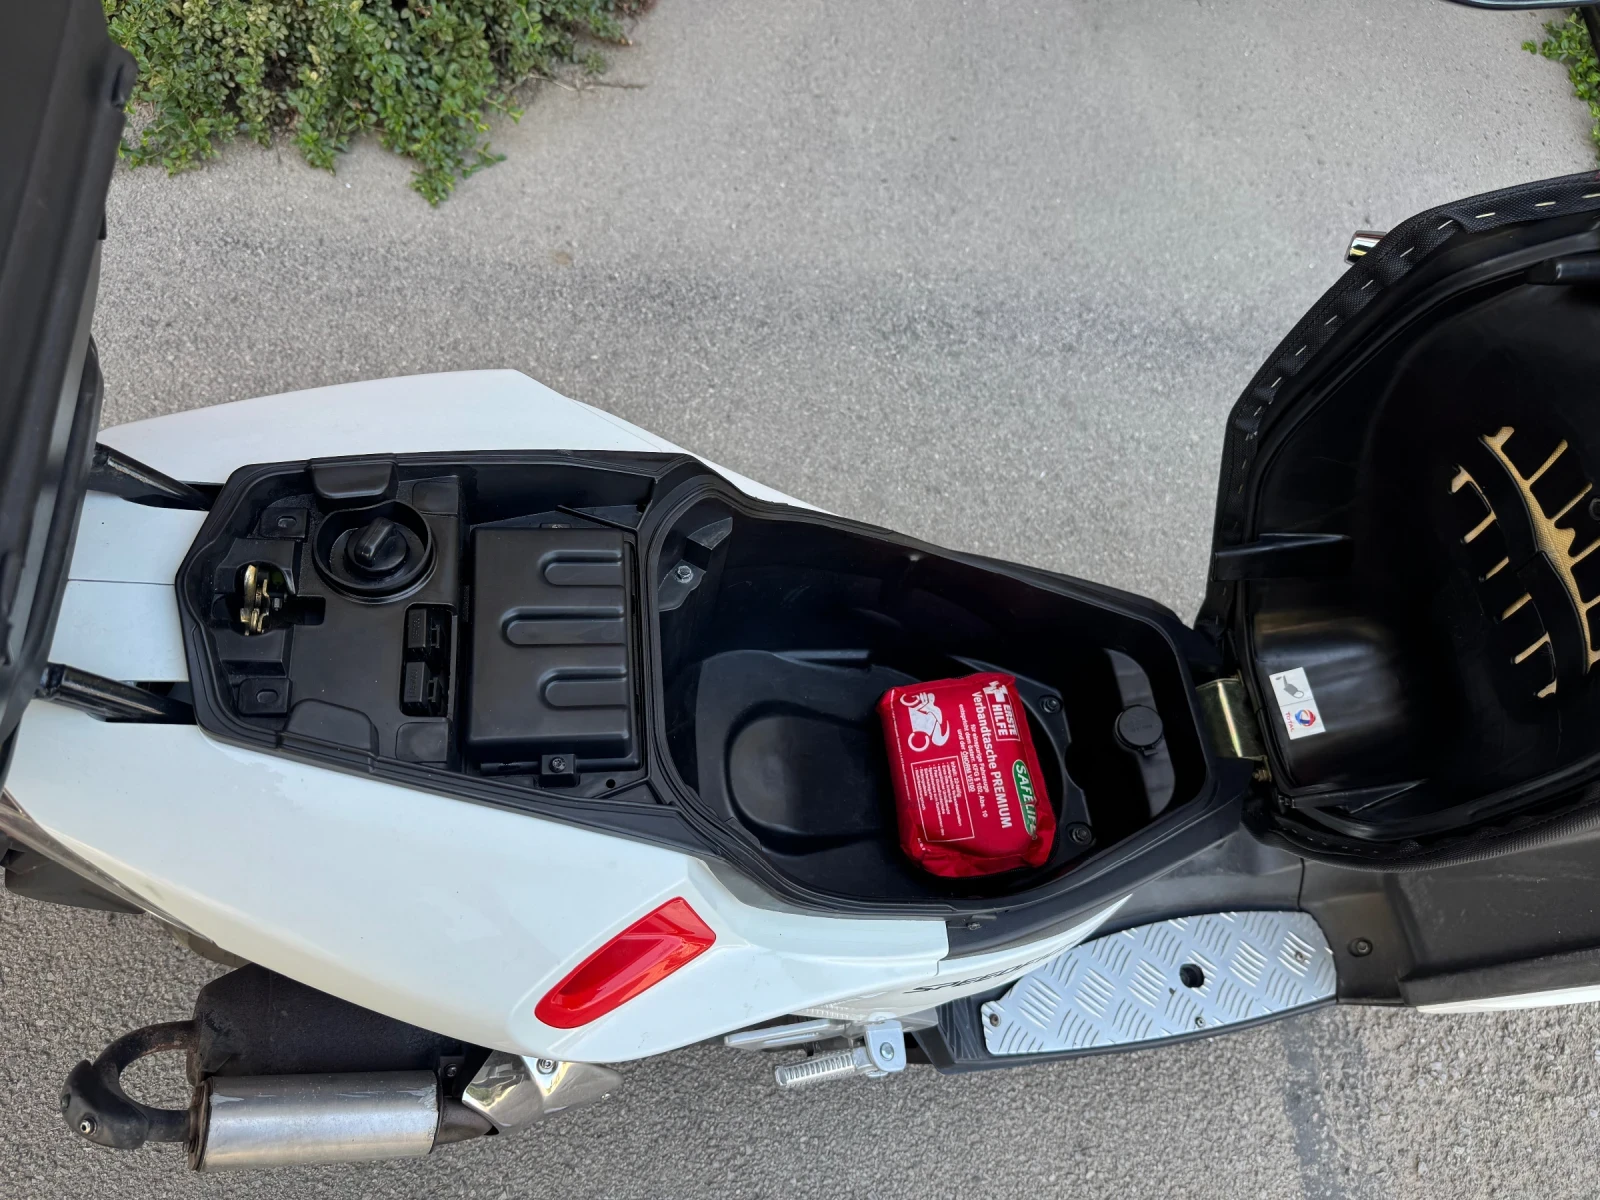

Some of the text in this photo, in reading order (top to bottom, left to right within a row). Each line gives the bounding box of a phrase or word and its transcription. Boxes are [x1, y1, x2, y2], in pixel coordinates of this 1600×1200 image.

[992, 704, 1008, 736] HILFE
[1003, 704, 1018, 736] ERSTE
[1286, 712, 1294, 732] TOTAL
[972, 691, 1012, 828] Verbandtasche PREMIUM
